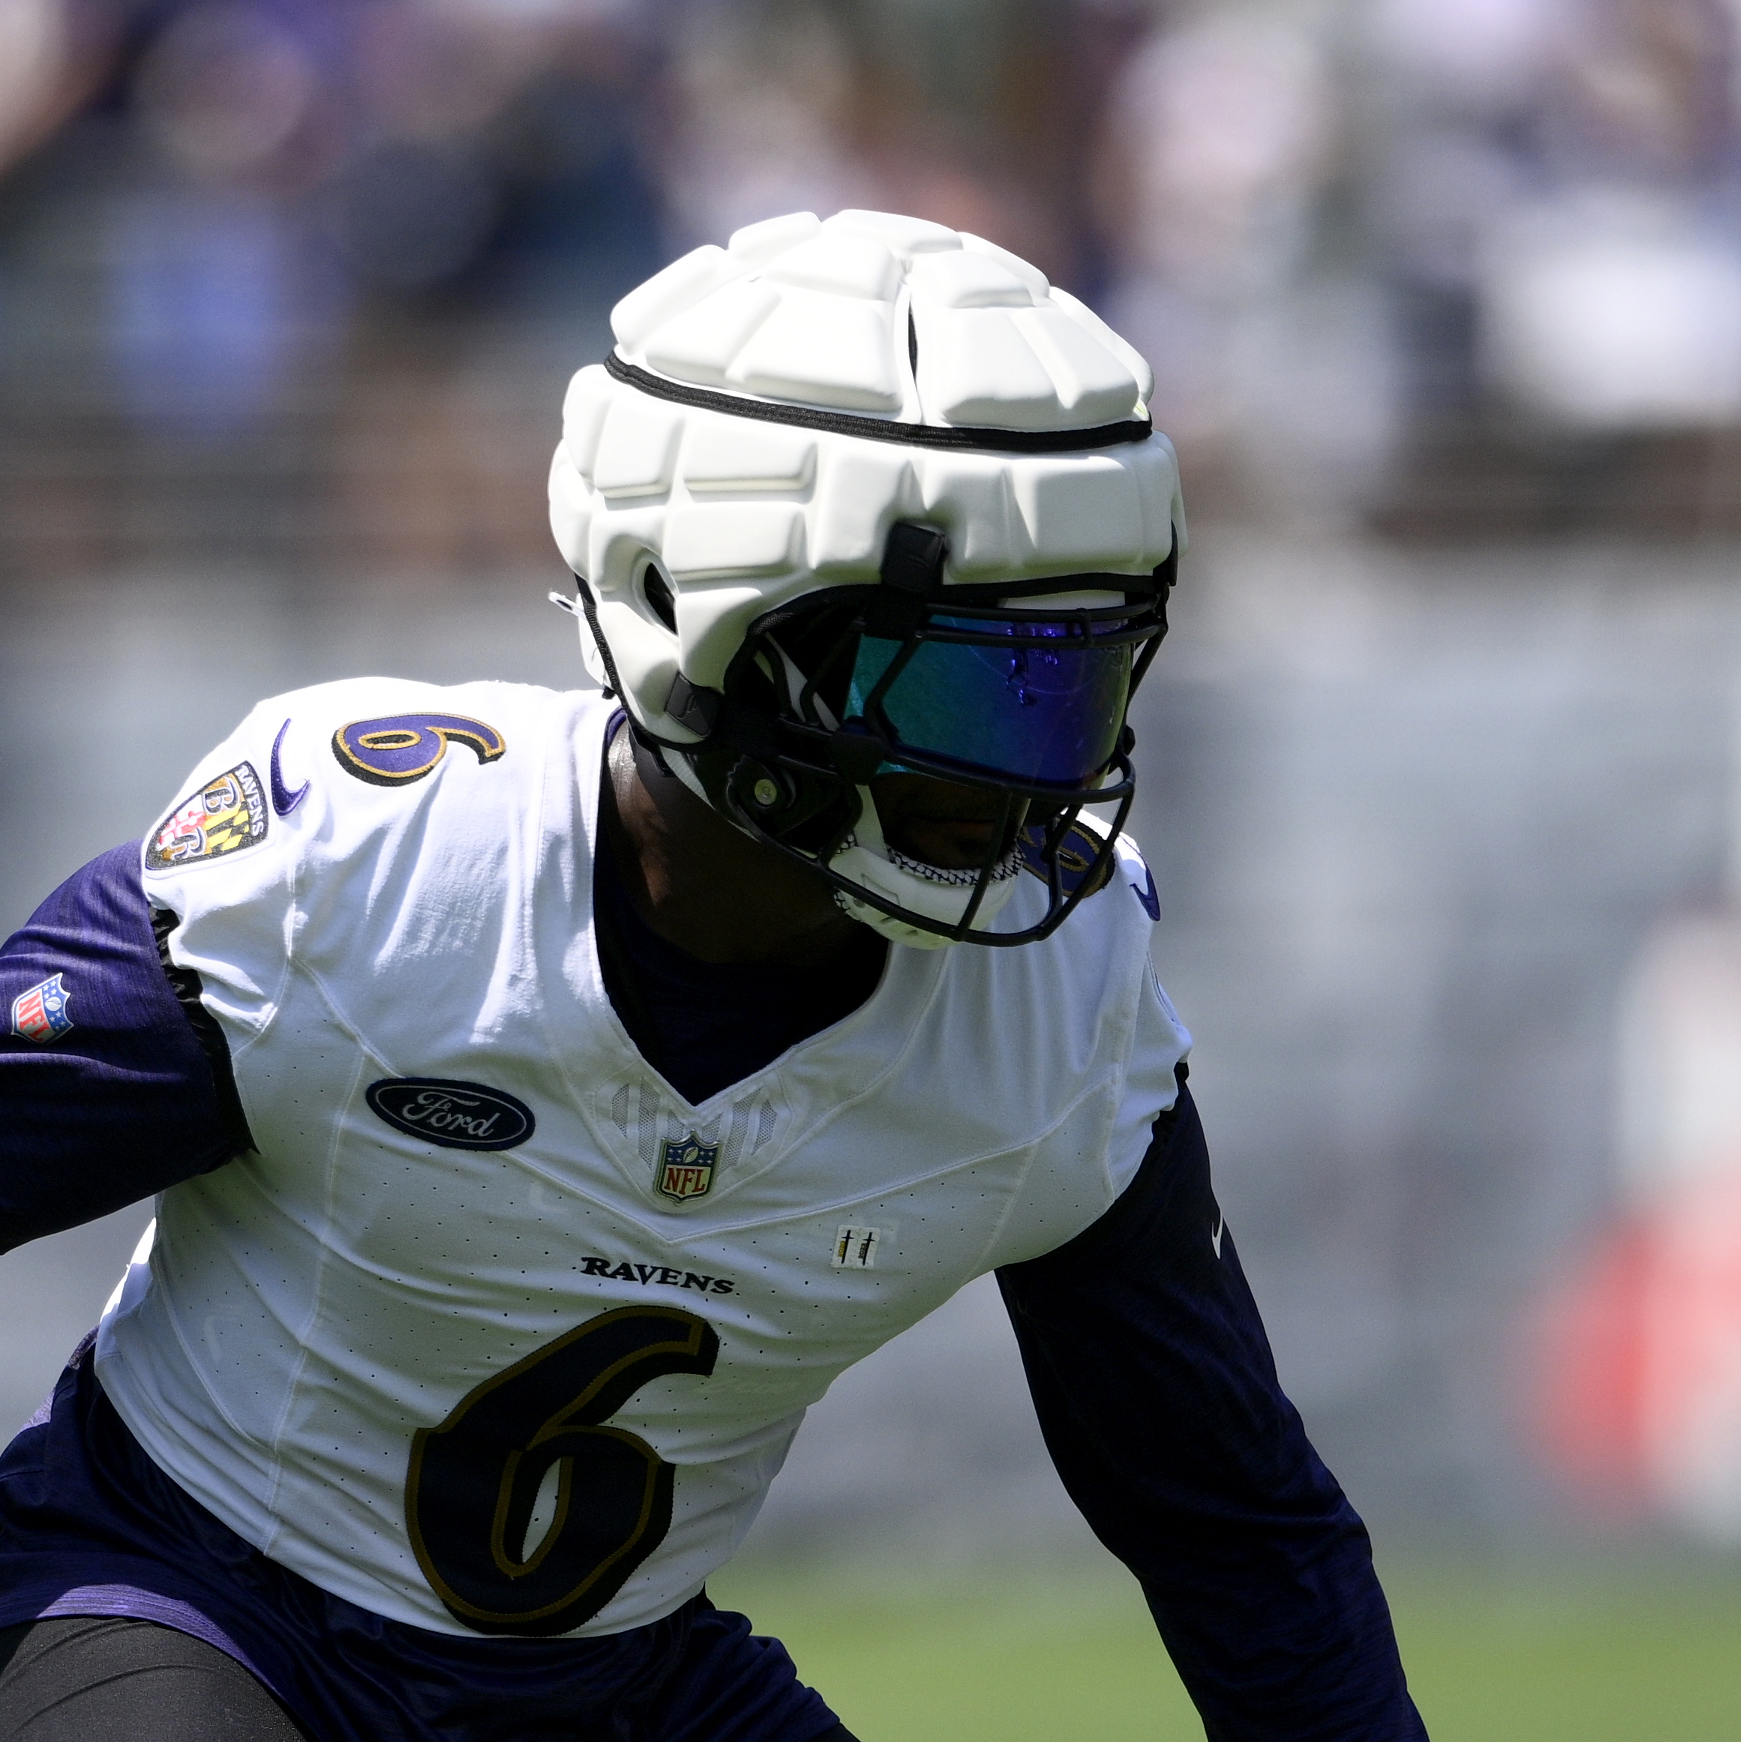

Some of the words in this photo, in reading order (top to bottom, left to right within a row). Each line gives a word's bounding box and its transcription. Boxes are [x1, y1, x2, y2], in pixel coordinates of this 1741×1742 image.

[331, 711, 506, 787] 6
[234, 764, 264, 837] RAVENS
[18, 991, 51, 1043] NFL
[403, 1091, 502, 1138] Ford
[664, 1167, 706, 1195] NFL
[580, 1256, 735, 1294] RAVENS
[404, 1304, 721, 1638] 6
